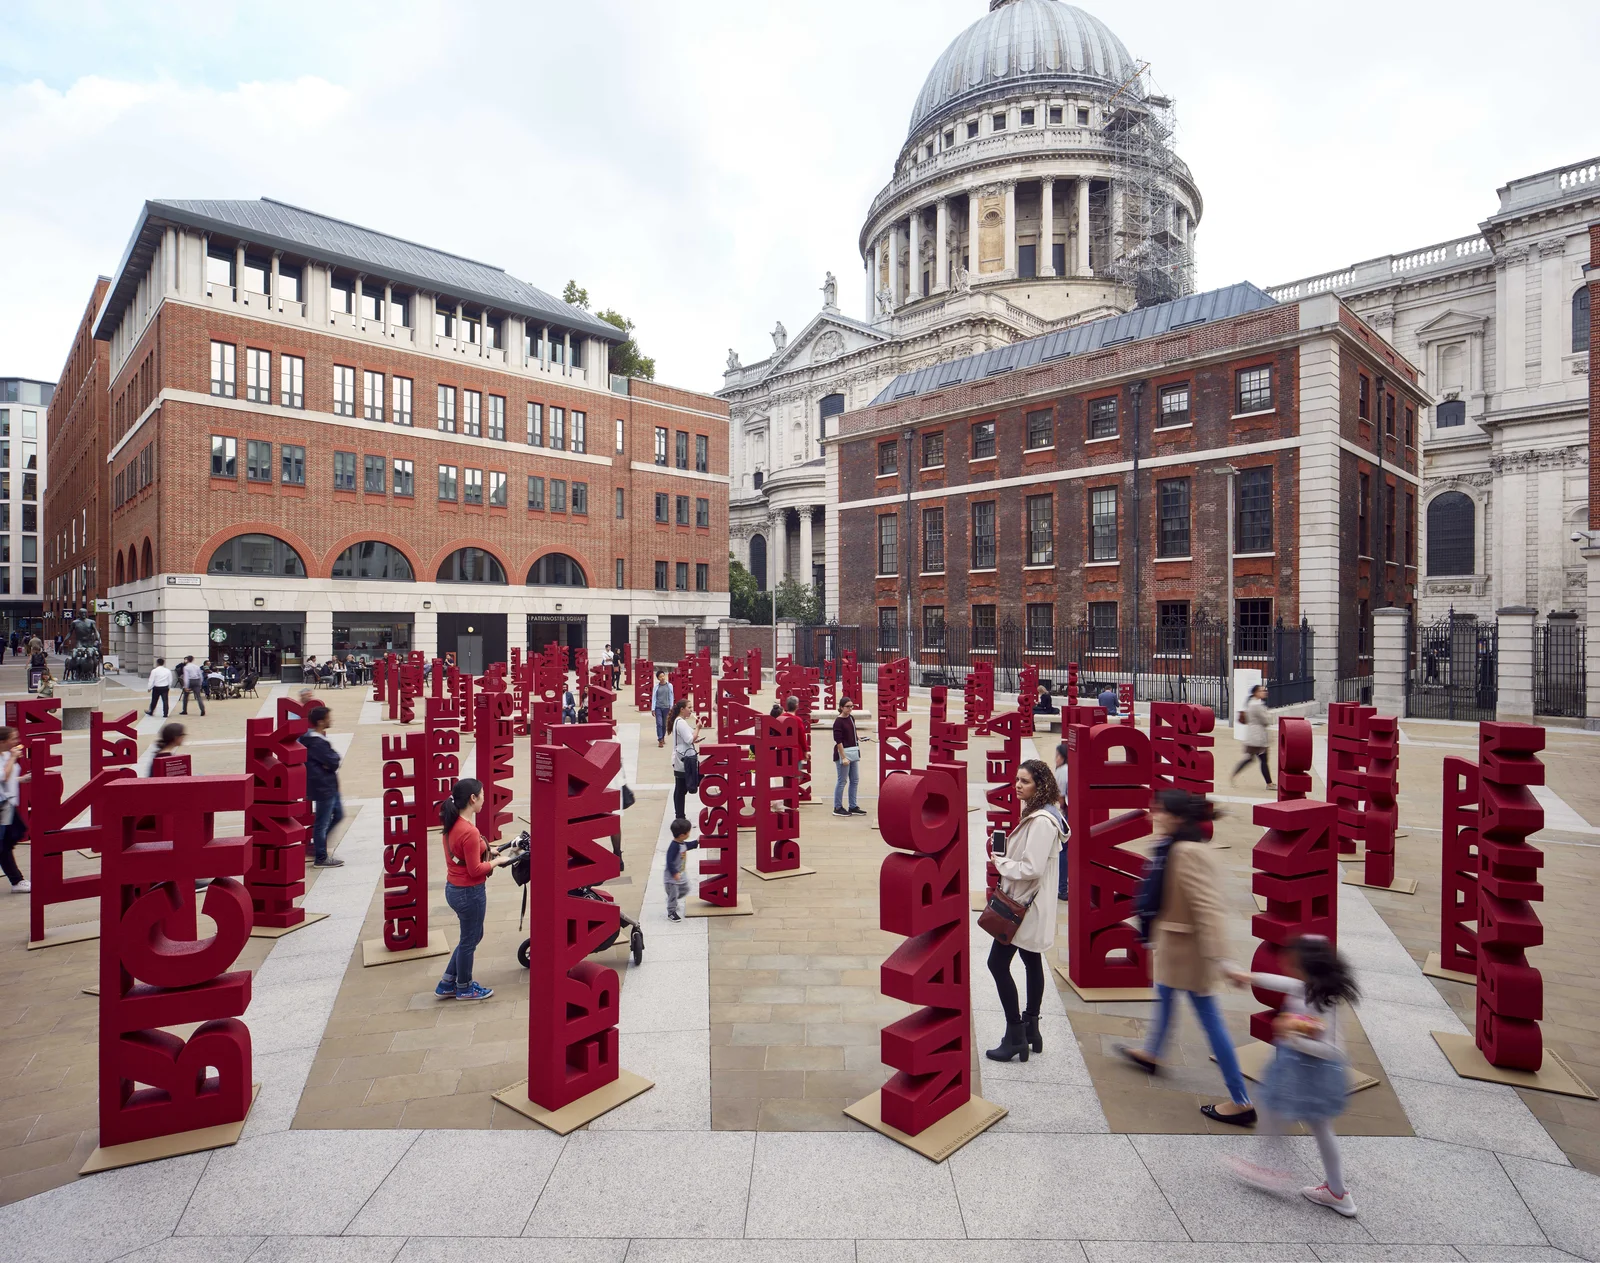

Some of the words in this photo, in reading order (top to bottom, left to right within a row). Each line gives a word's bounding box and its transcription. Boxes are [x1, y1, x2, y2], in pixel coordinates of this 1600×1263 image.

[512, 682, 525, 736] AILEEN
[824, 659, 836, 710] TRACEY
[382, 734, 422, 951] GIUSEPPE
[699, 744, 735, 907] ALISON
